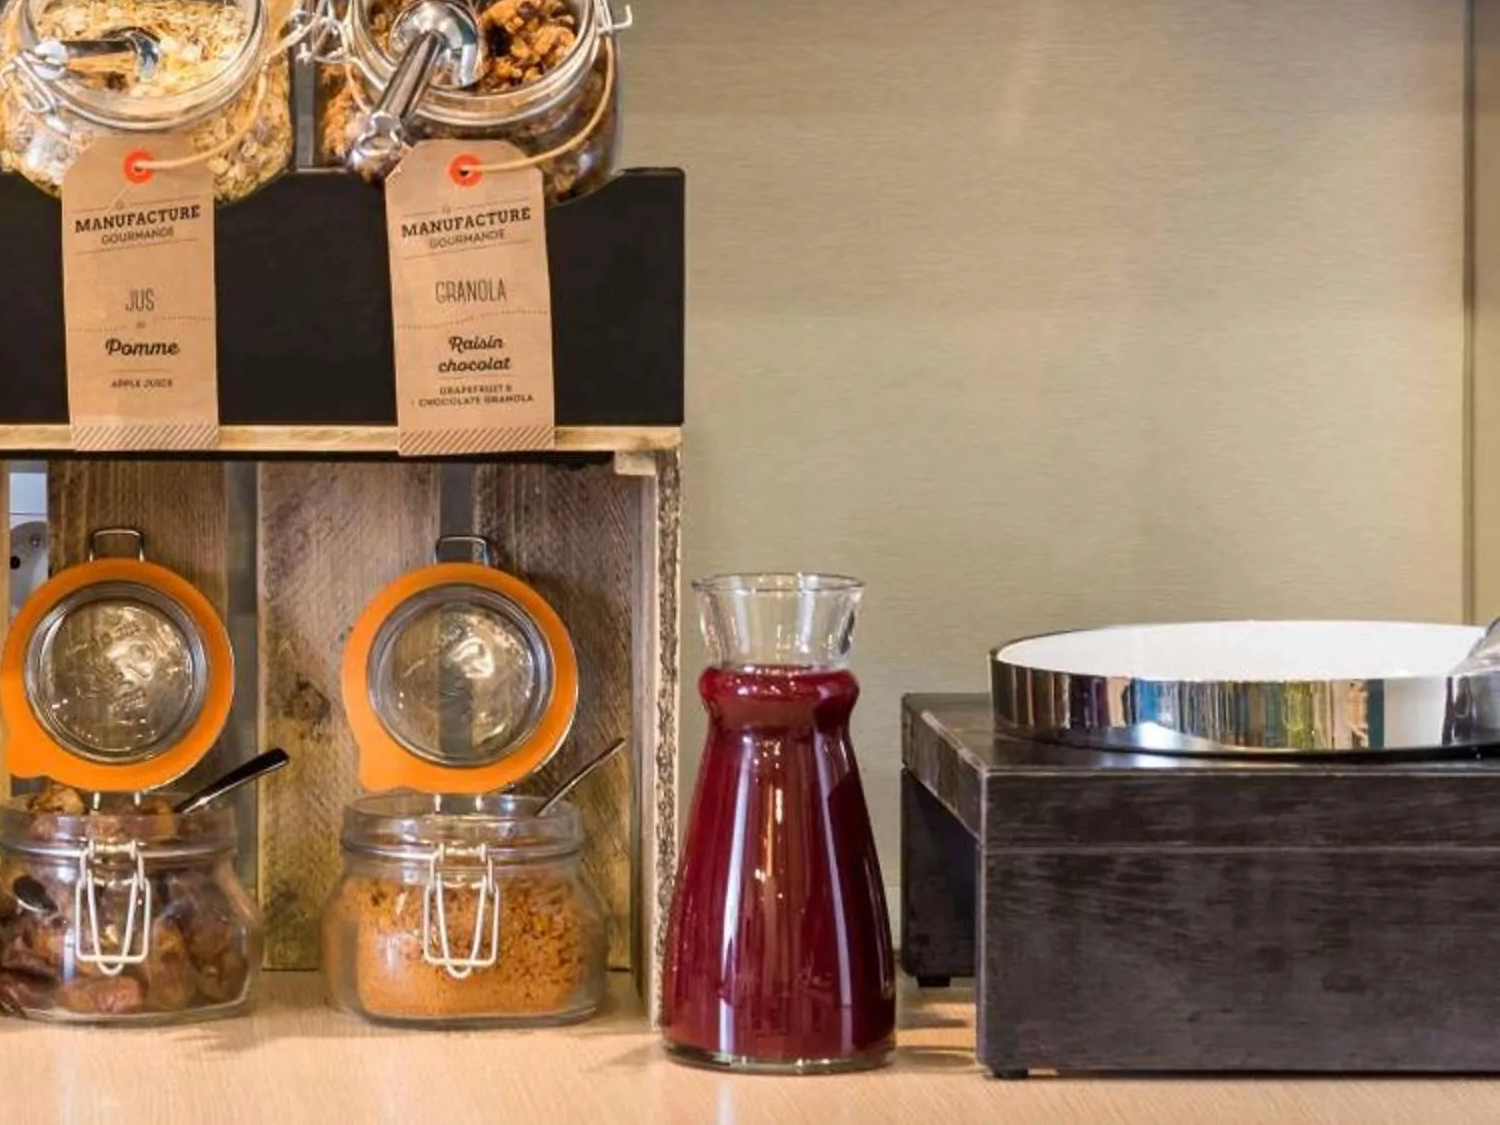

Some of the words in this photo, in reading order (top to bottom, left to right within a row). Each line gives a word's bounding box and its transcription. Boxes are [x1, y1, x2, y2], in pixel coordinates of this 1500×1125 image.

[75, 203, 201, 234] MANUFACTURE
[401, 206, 531, 238] MANUFACTURE
[125, 286, 155, 313] JUS
[435, 277, 507, 305] GRANOLA
[105, 337, 181, 357] Pomme
[448, 334, 504, 355] Raisin
[437, 357, 512, 374] chocolat
